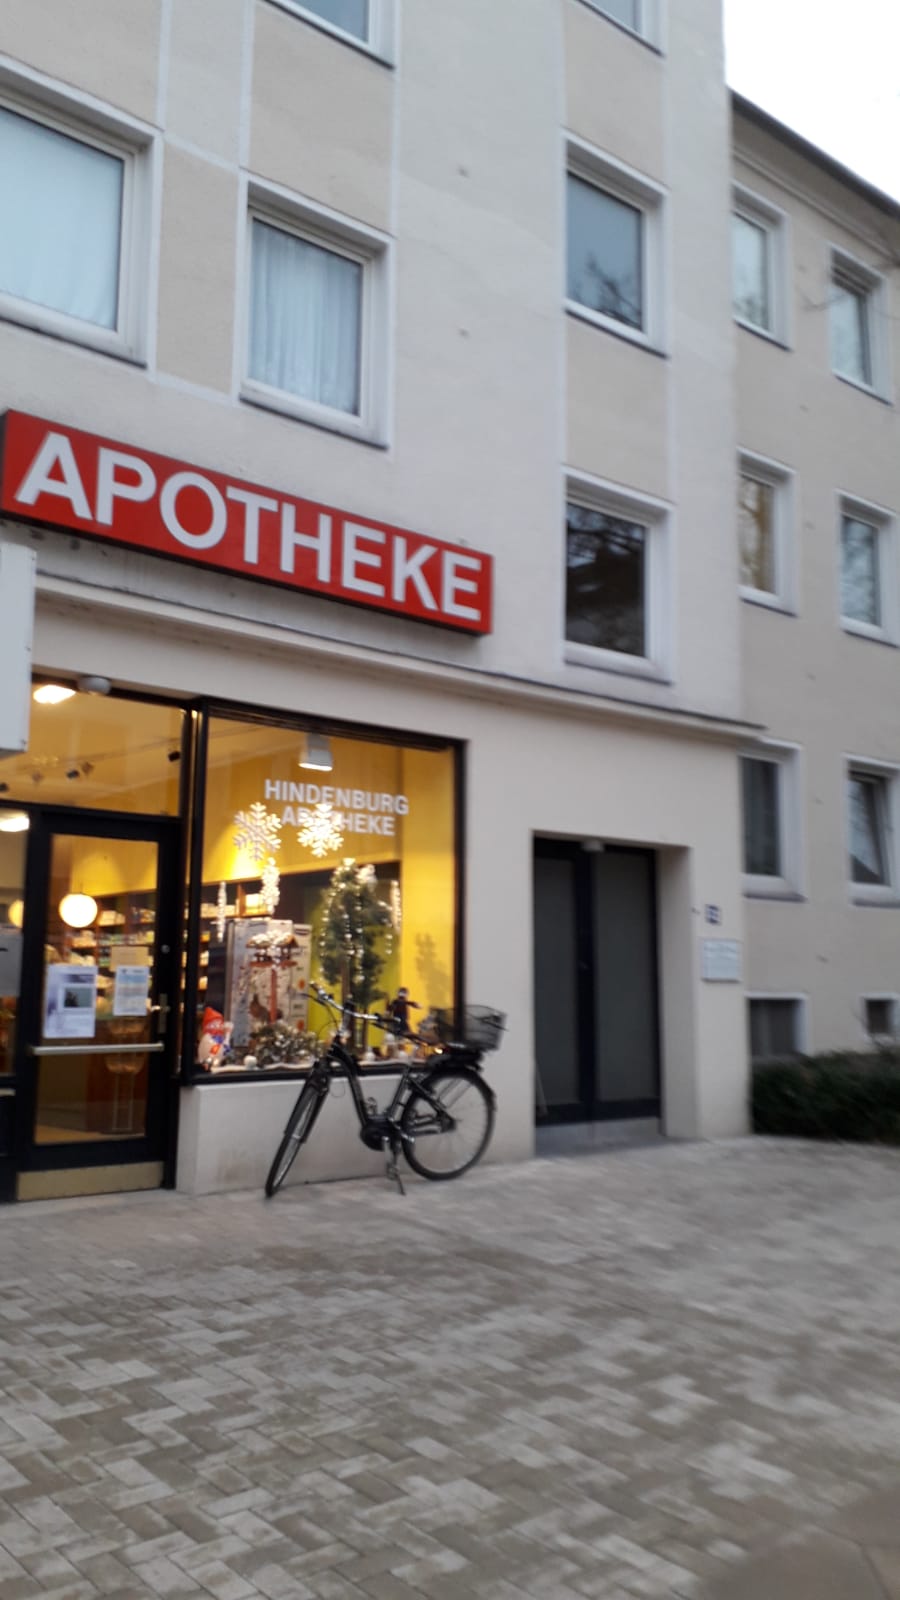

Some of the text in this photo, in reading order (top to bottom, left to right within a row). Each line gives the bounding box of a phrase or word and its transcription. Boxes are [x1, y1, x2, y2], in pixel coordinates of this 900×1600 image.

[15, 431, 482, 622] APOTHEKE
[264, 778, 409, 815] HINDENBURG
[281, 805, 396, 837] APHEKE
